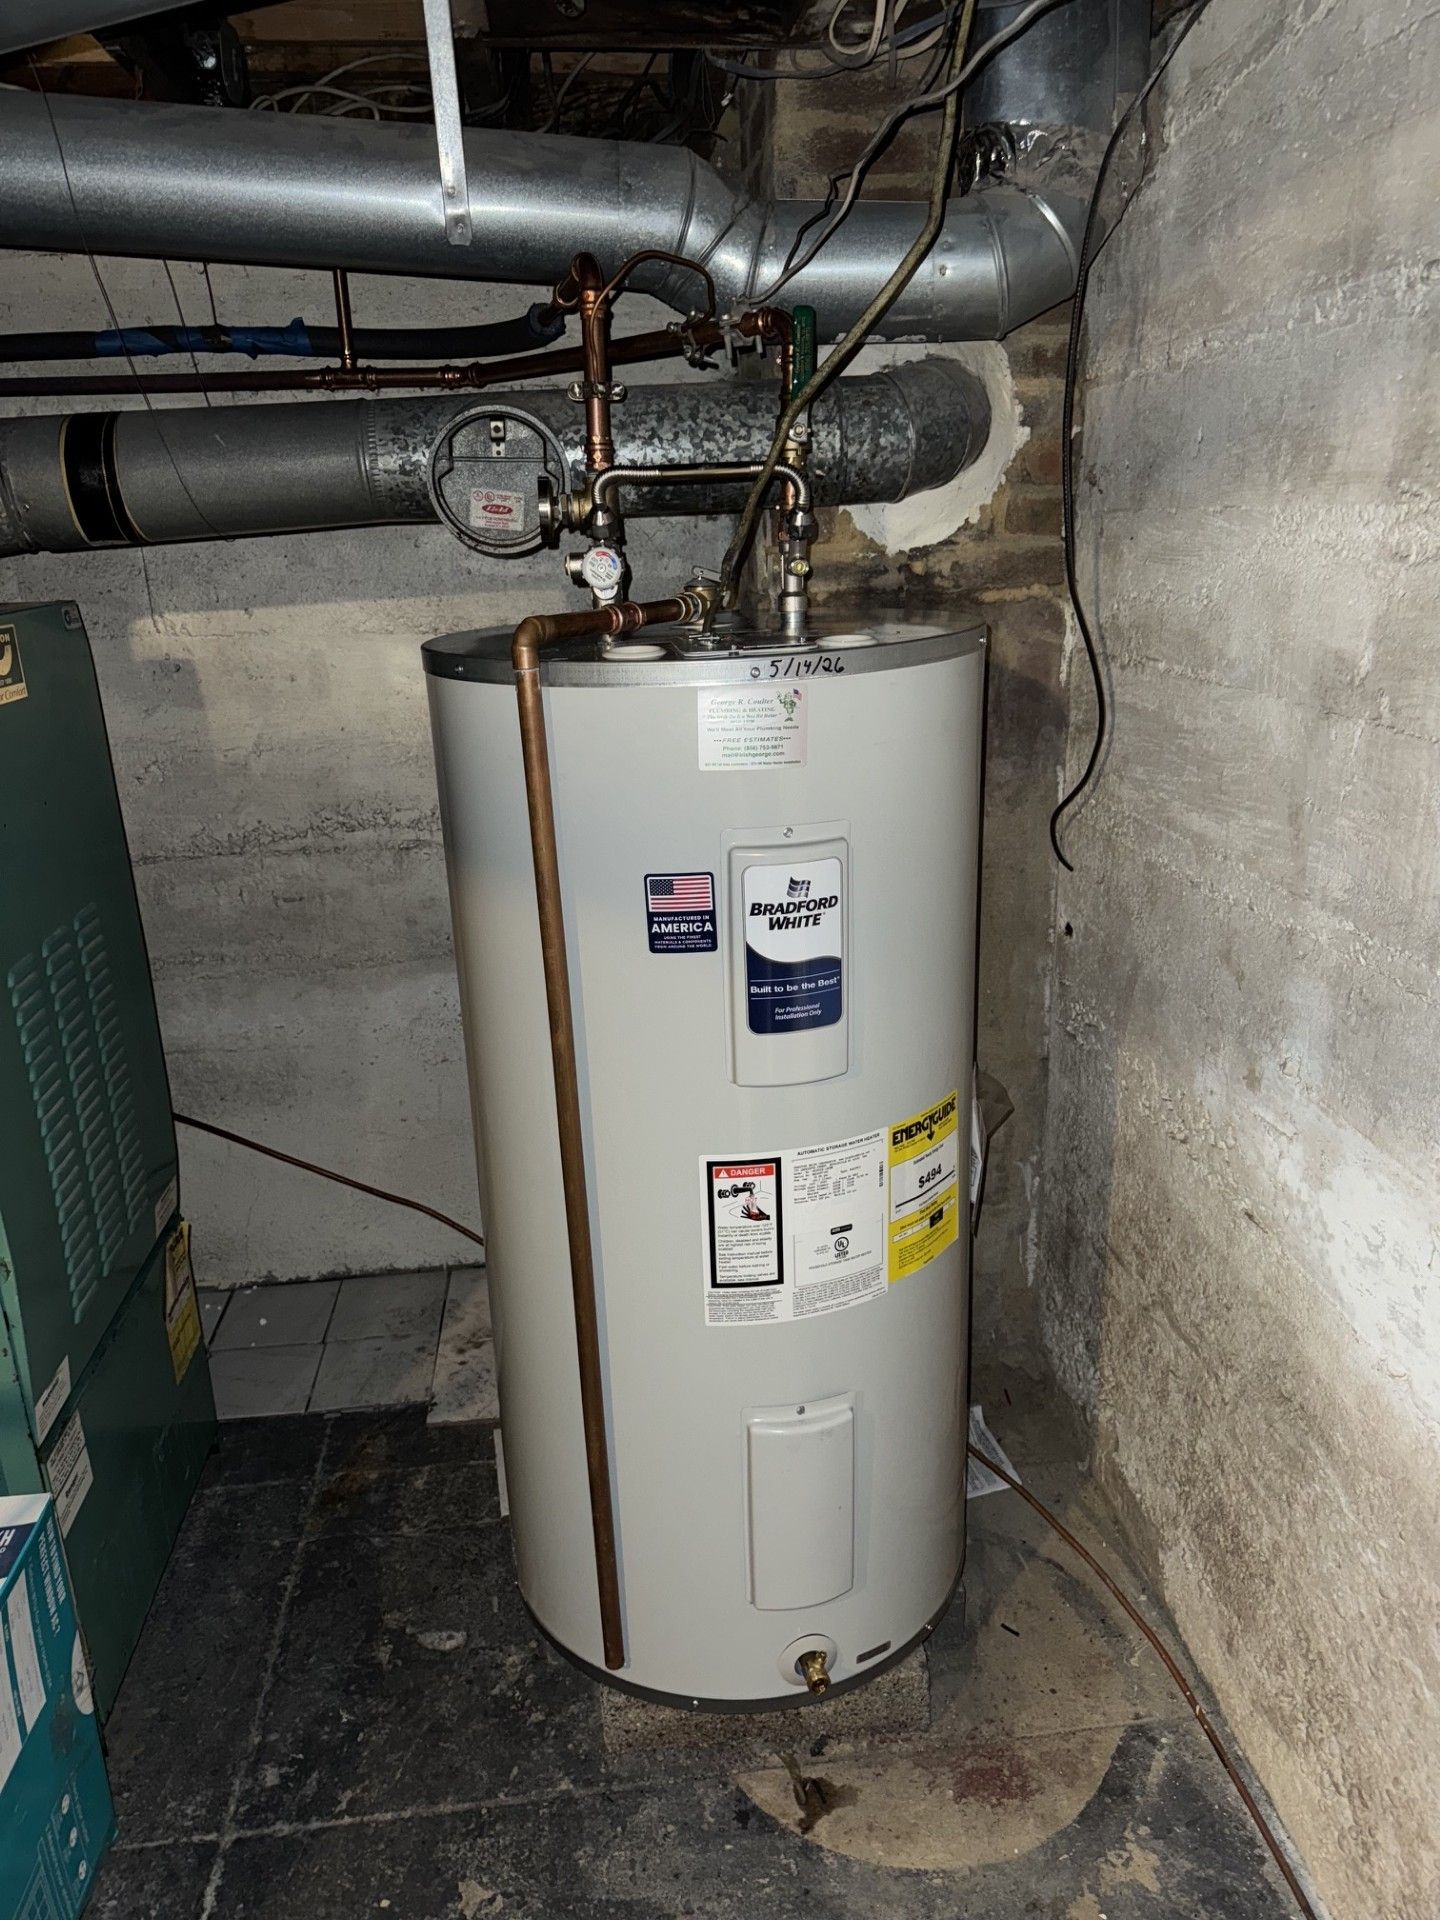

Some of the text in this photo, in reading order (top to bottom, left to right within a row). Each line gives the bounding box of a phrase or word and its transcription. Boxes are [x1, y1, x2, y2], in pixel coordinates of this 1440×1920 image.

[769, 656, 845, 677] 5/14/26
[749, 895, 839, 916] BRADFORD
[651, 922, 714, 933] AMERICA
[768, 913, 823, 931] WHITE
[750, 985, 772, 994] Built
[774, 985, 784, 993] to
[786, 984, 799, 992] be
[801, 981, 816, 990] the
[785, 1002, 821, 1013] Professional
[774, 1009, 822, 1020] Installation Only
[797, 1147, 825, 1156] AUTOMATIC
[826, 1143, 848, 1151] STORAGE
[848, 1138, 864, 1146] WATER
[730, 1167, 766, 1177] DANGER
